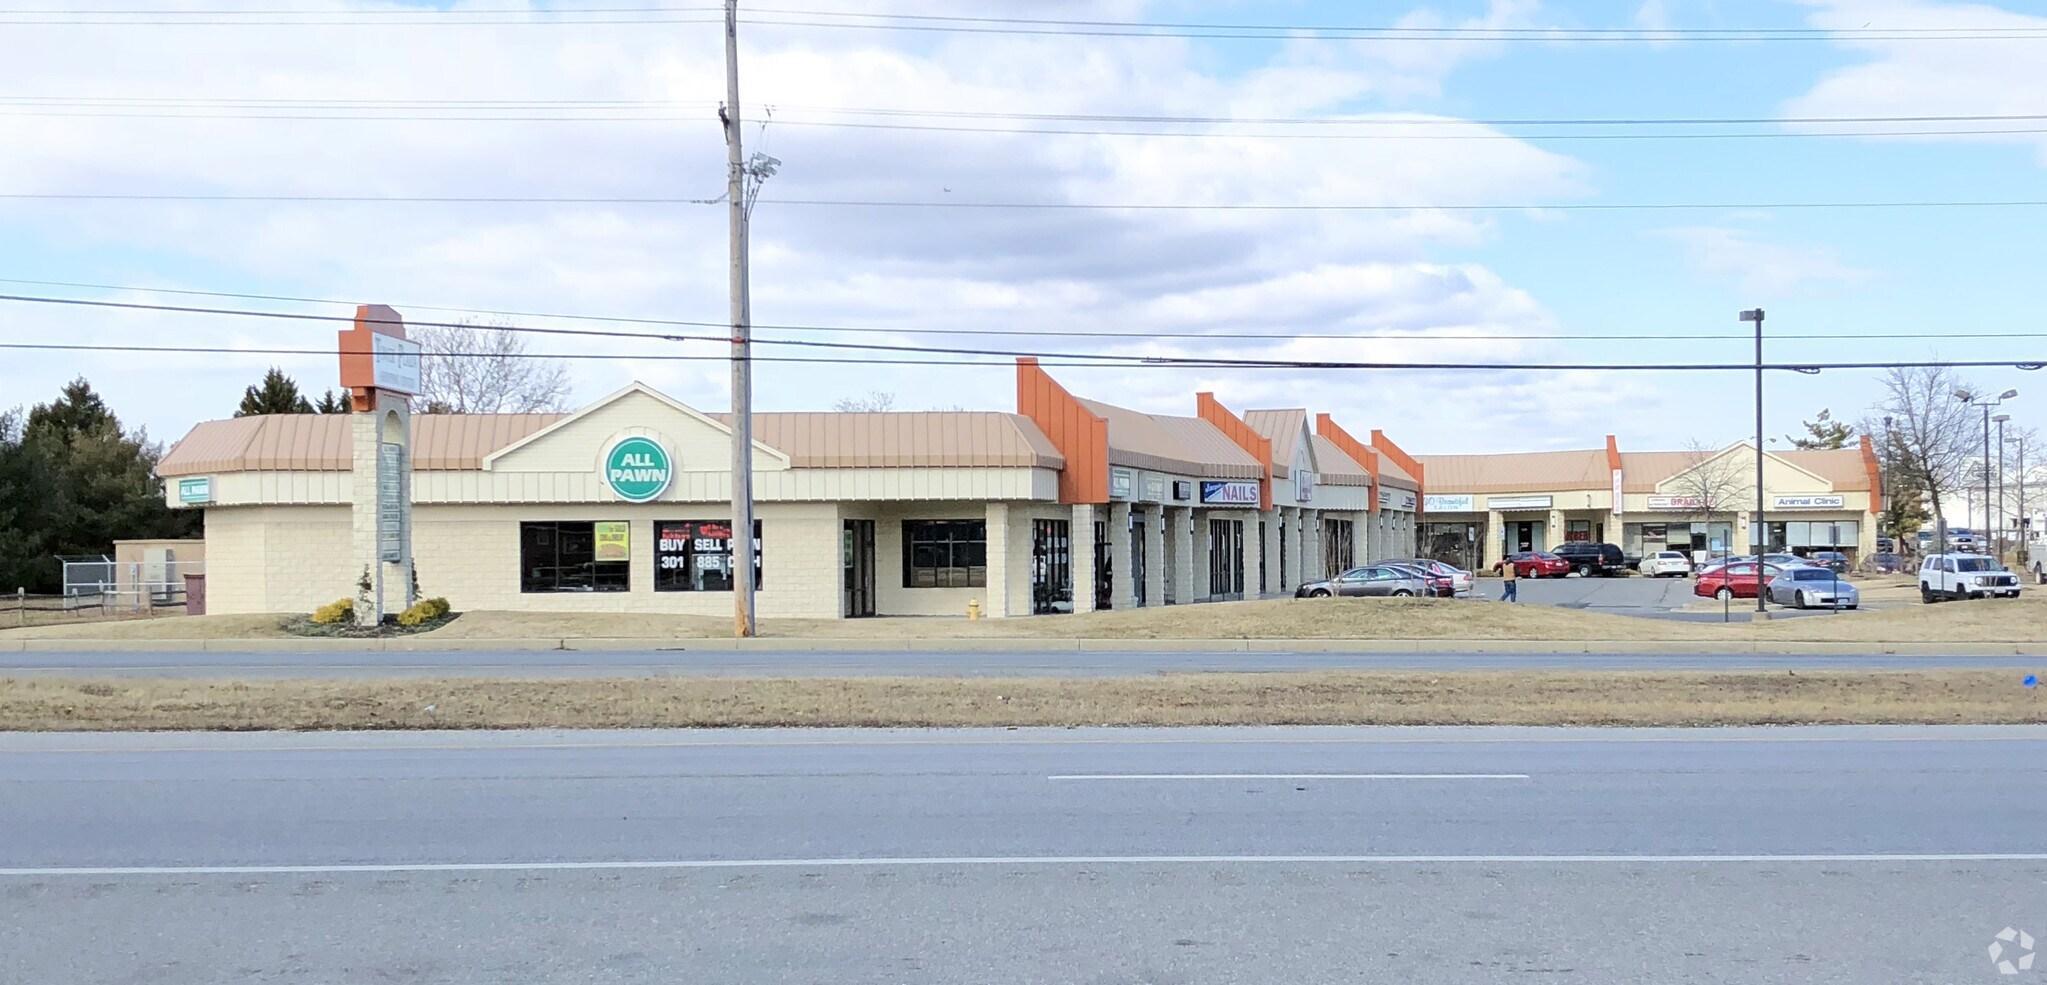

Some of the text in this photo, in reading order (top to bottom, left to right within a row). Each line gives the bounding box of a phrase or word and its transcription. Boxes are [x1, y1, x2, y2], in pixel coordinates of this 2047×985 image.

[621, 453, 655, 467] ALL
[611, 469, 666, 482] PAWN
[1222, 485, 1257, 502] NAILS
[1778, 497, 1840, 505] Animal Clinic
[660, 538, 761, 551] BUY SELL PN
[661, 556, 684, 569] 301
[697, 556, 720, 568] 885
